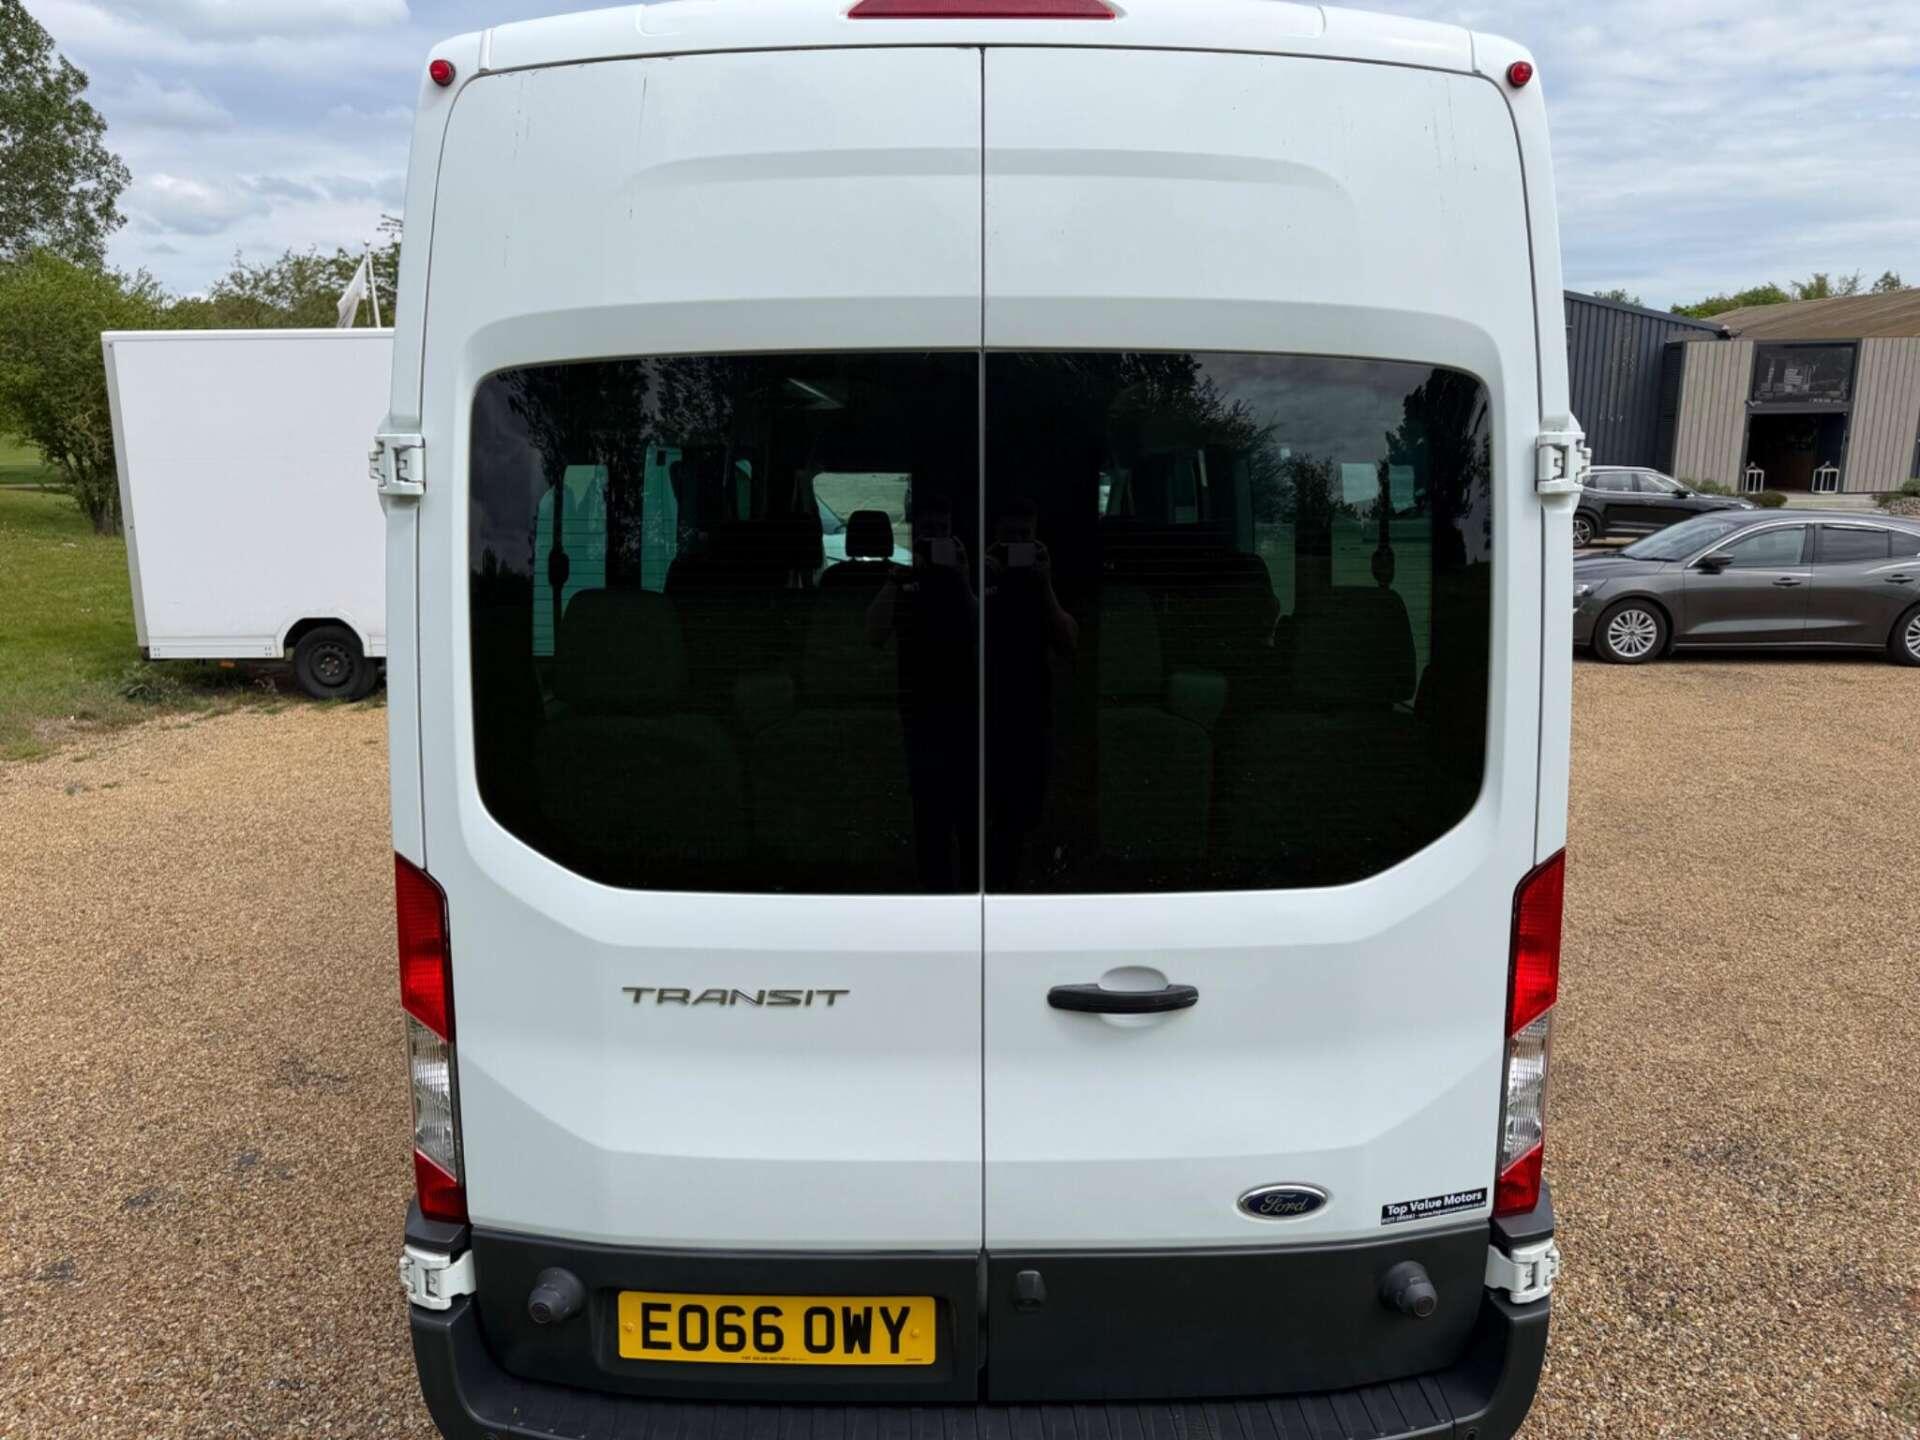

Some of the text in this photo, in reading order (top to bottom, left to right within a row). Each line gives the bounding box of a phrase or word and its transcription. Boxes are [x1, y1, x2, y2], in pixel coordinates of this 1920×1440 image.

[622, 986, 850, 1007] TRANSIT
[1259, 1193, 1309, 1213] Ford
[1387, 1205, 1408, 1216] Top
[1410, 1199, 1442, 1212] Value
[1443, 1191, 1482, 1206] Motors
[641, 1302, 911, 1354] EO66 OWY
